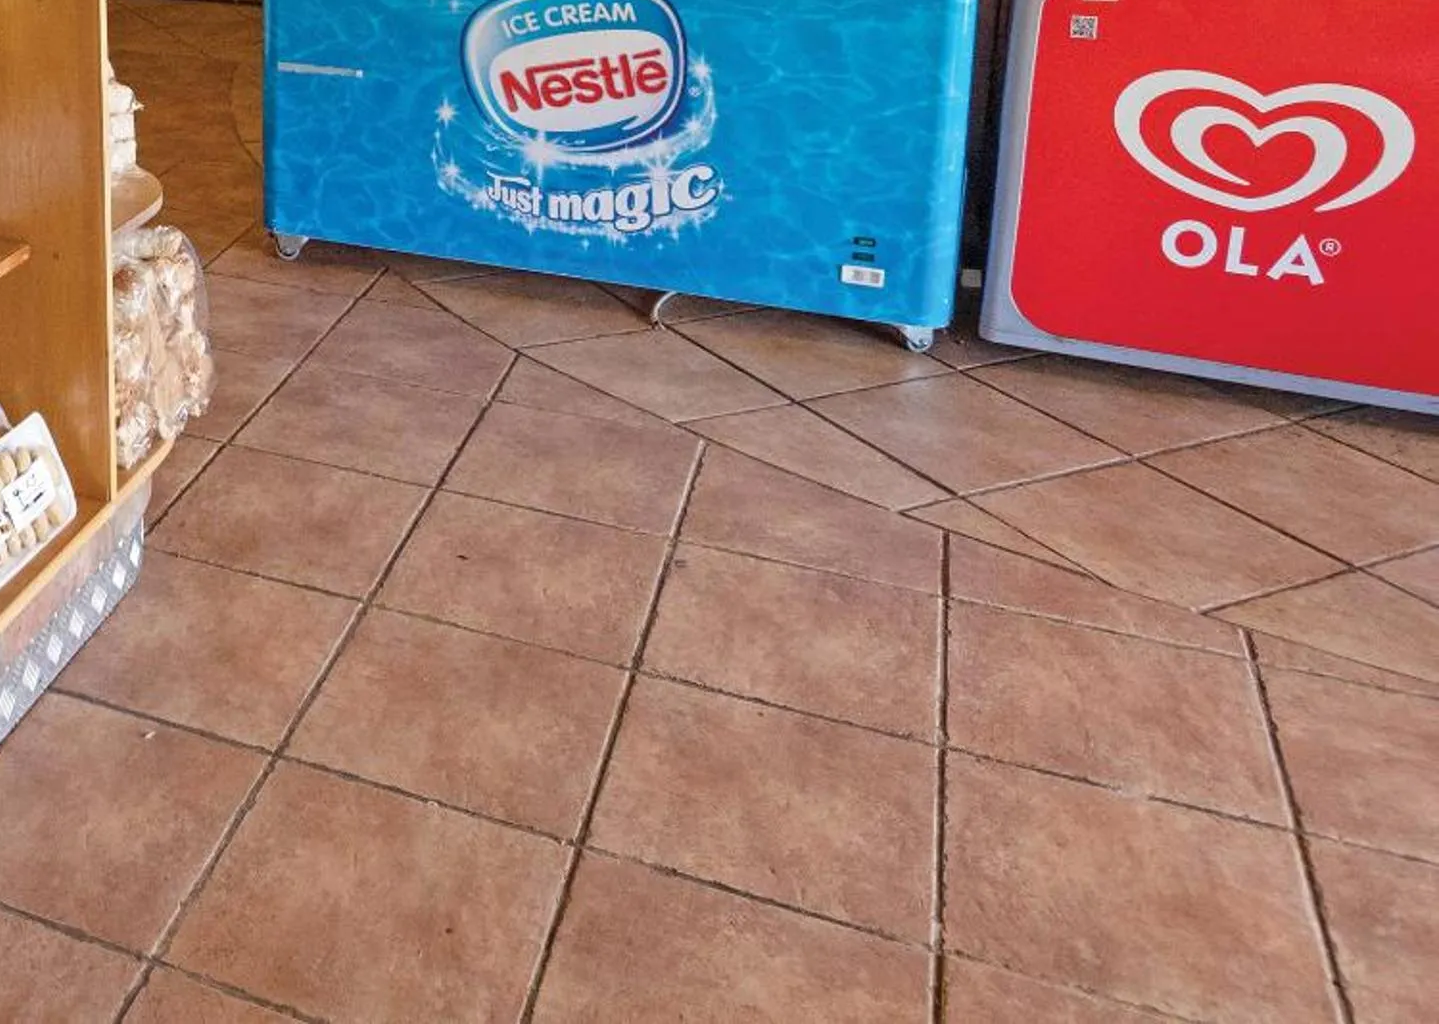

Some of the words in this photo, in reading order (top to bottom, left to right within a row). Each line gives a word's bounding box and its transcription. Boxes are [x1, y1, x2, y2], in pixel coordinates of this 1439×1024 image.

[501, 11, 541, 39] ICE
[544, 2, 637, 26] CREAM
[486, 170, 544, 217] Just
[548, 163, 717, 233] magic
